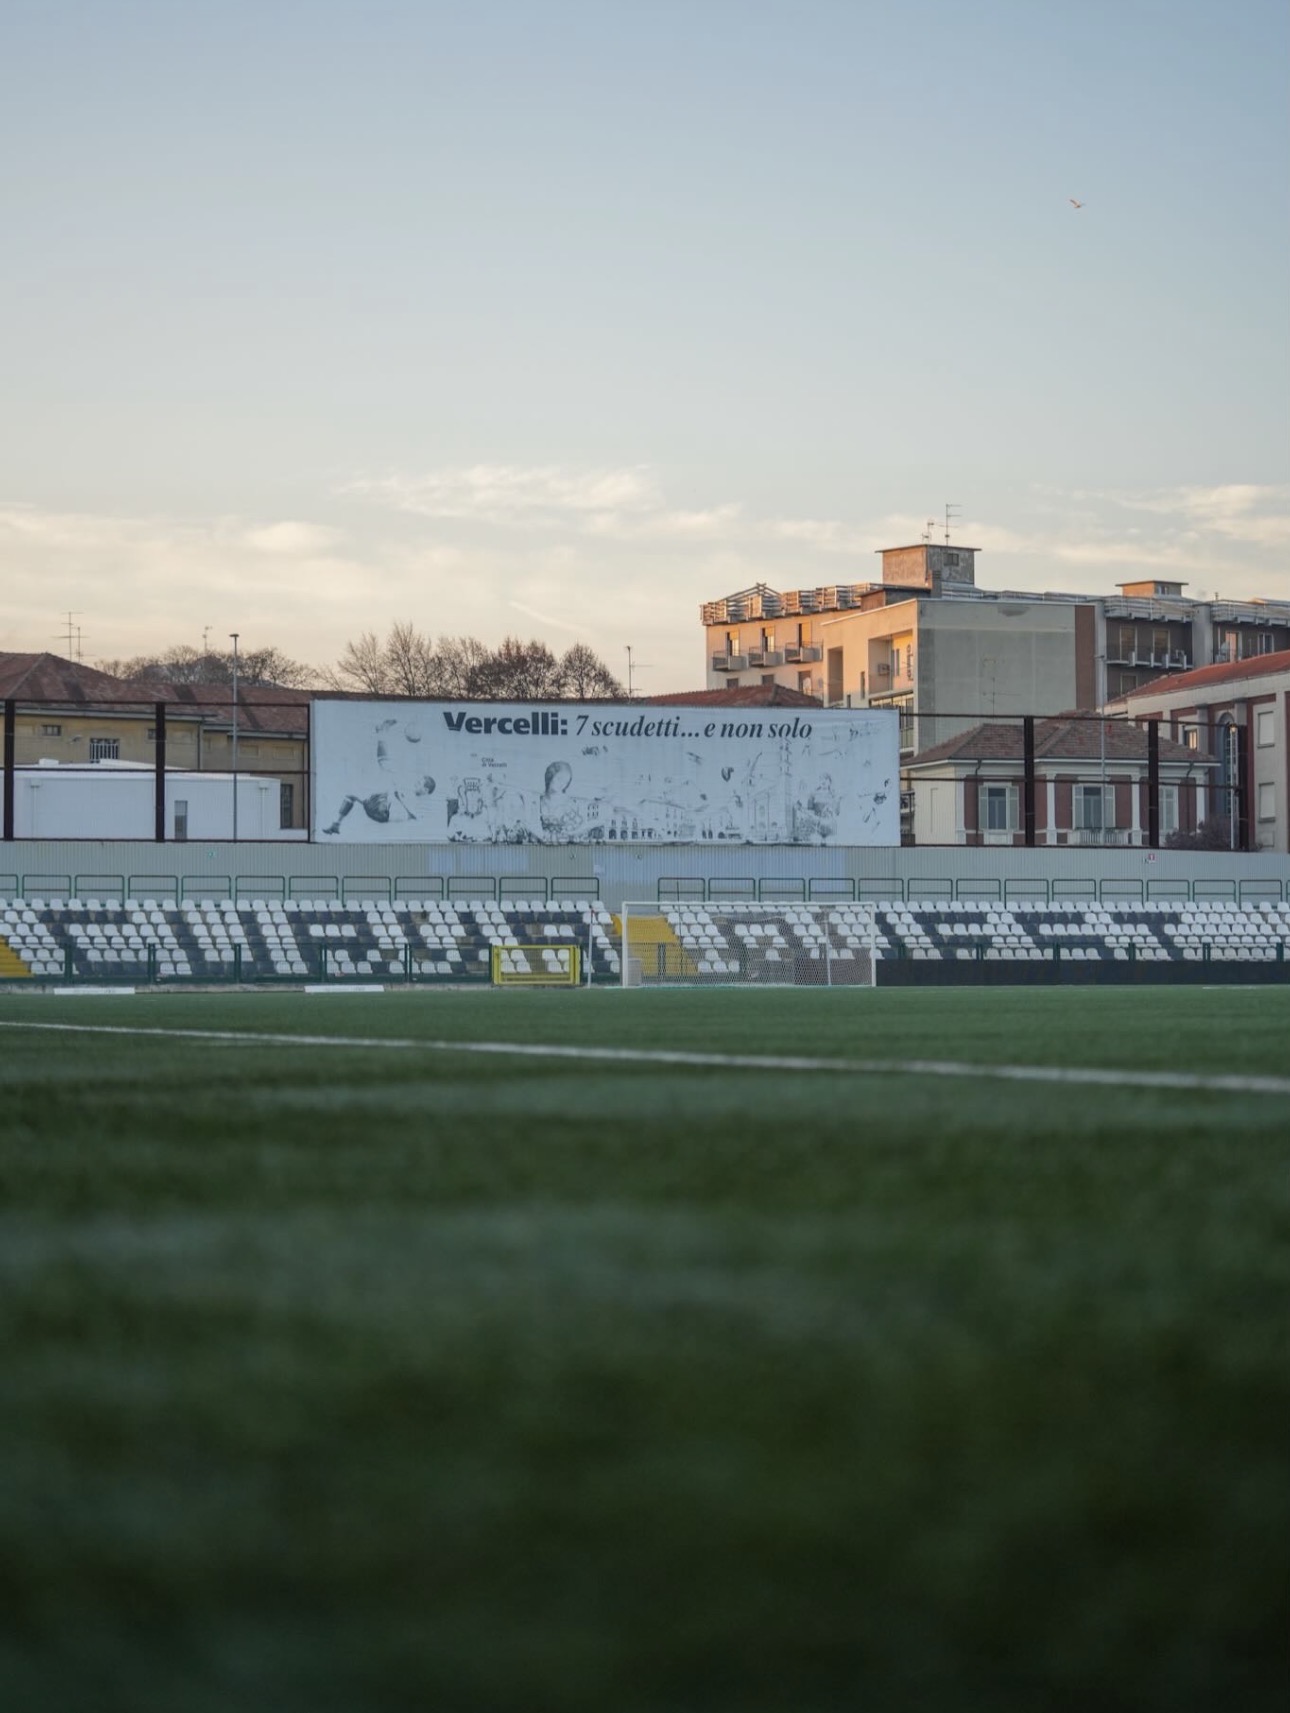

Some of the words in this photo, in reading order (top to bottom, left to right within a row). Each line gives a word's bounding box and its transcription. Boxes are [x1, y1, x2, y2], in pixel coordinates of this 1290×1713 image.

[442, 711, 568, 736] Vercelli:
[576, 714, 590, 736] 7
[720, 723, 763, 739] non
[767, 717, 813, 739] solo
